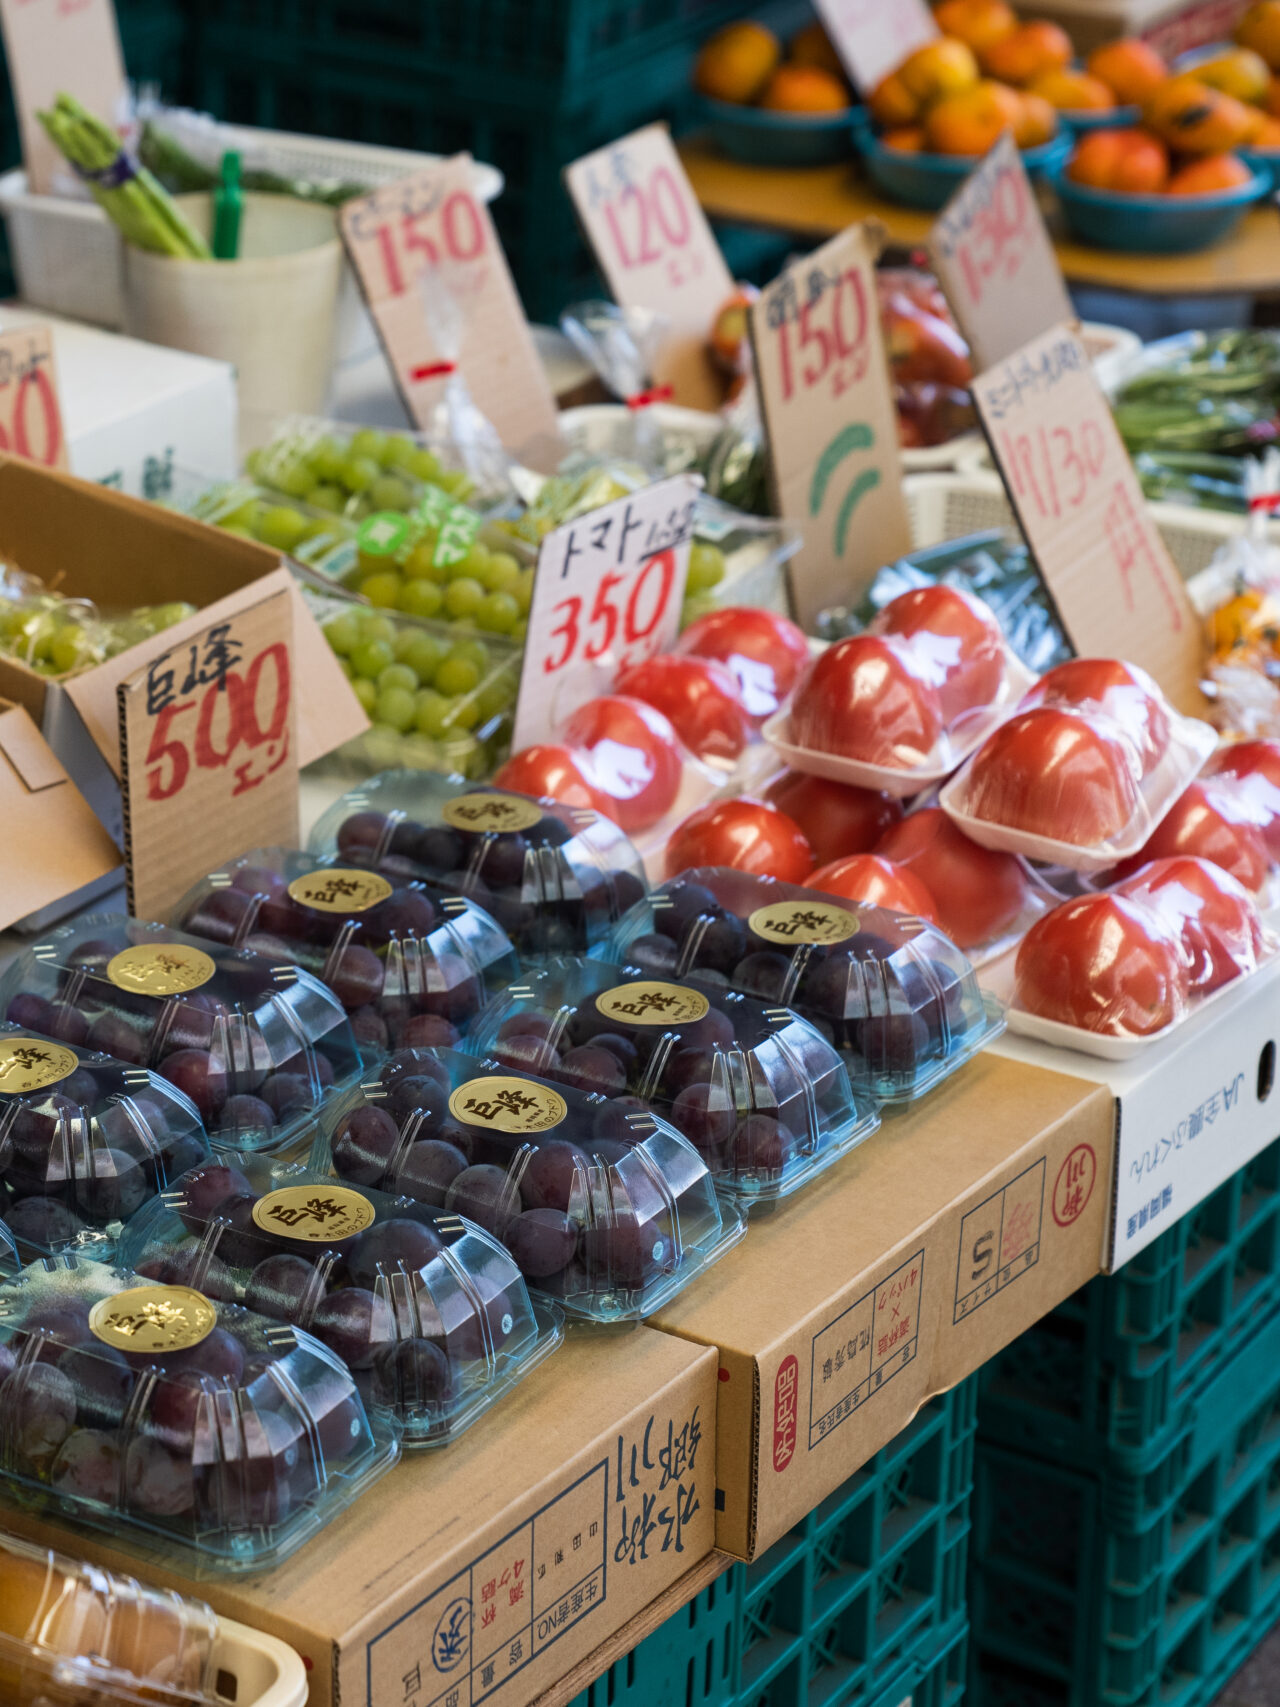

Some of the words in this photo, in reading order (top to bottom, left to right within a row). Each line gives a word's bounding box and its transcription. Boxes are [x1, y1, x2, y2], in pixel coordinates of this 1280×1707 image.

[377, 190, 486, 297] 150
[606, 165, 690, 268] 120
[778, 267, 867, 402] 150
[561, 503, 642, 579] トマト
[544, 547, 677, 674] 350
[147, 624, 243, 716] 巨峰
[145, 641, 291, 800] 500
[764, 911, 832, 935] 巨峰
[611, 993, 681, 1016] 巨峰
[463, 1090, 540, 1120] 巨峰
[267, 1199, 347, 1226] 巨峰
[971, 1230, 995, 1280] S
[878, 1268, 919, 1311] 4パック
[819, 1389, 861, 1434] 生産者氏名
